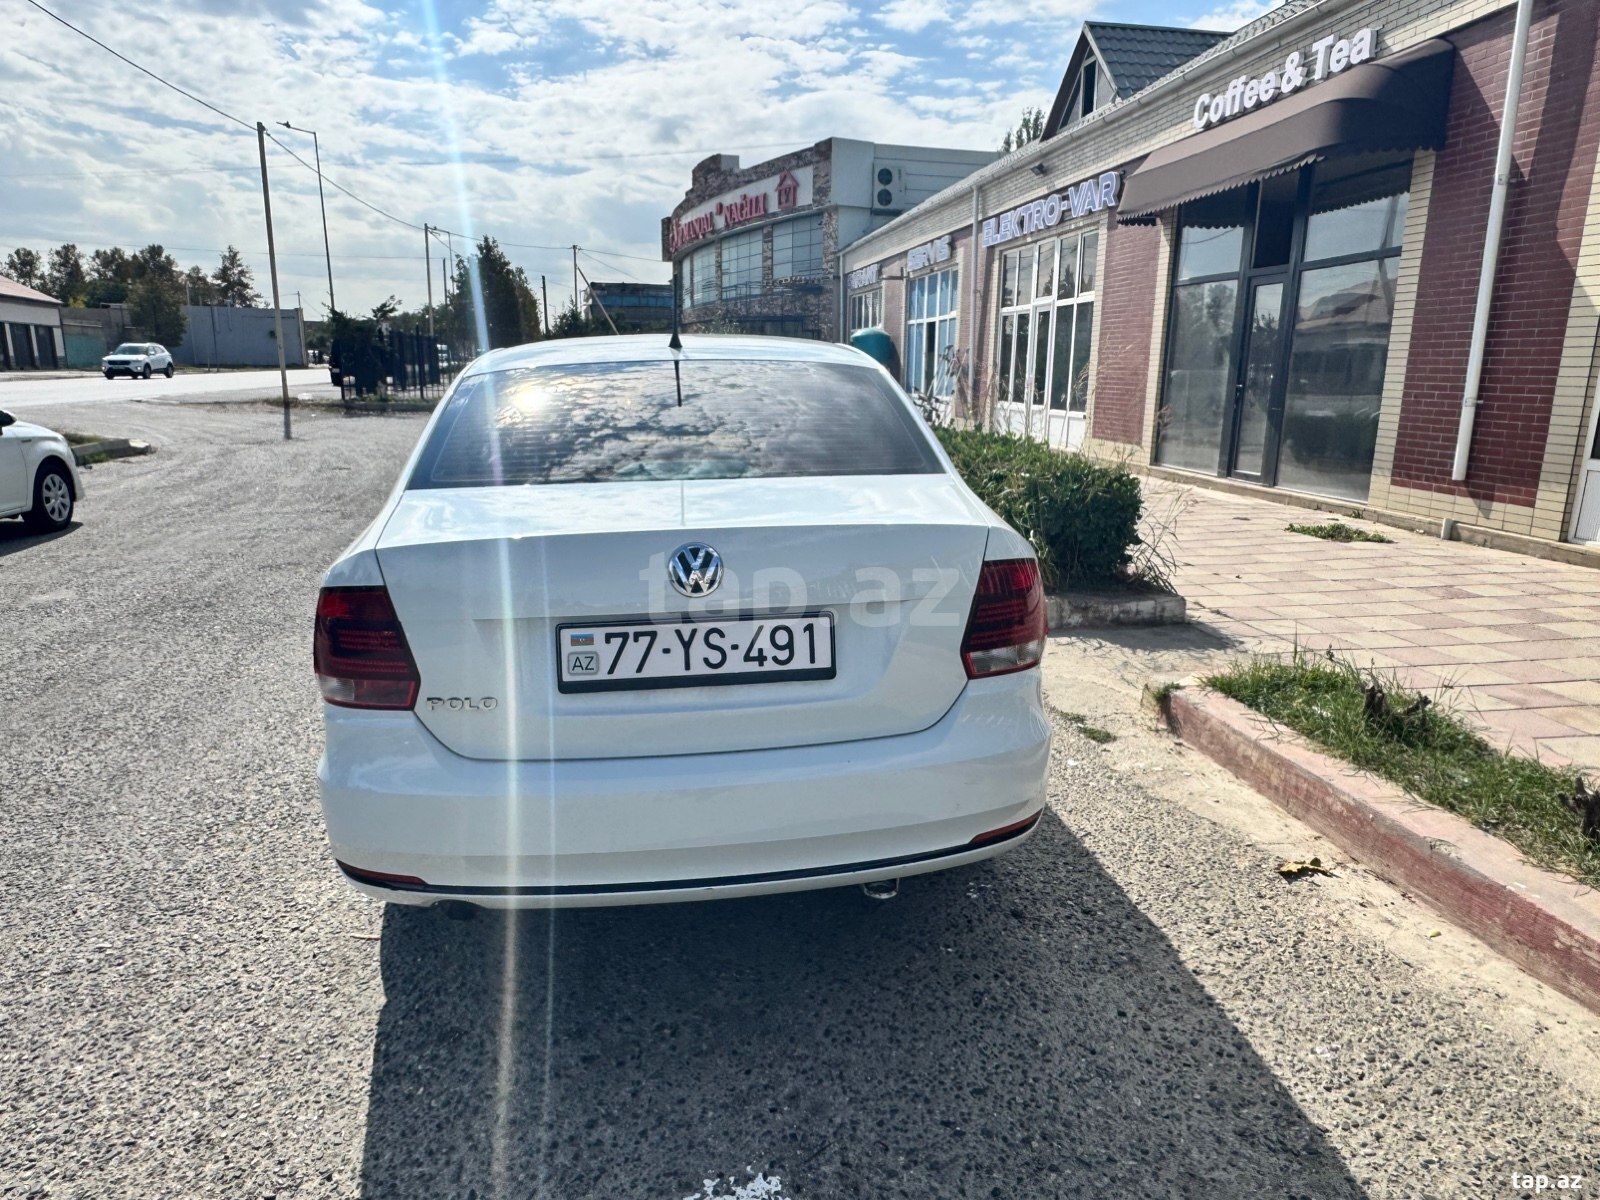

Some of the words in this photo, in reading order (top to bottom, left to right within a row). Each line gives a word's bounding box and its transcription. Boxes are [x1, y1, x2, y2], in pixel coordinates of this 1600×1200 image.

[1193, 71, 1280, 129] Coffee
[1281, 51, 1307, 94] &
[1311, 28, 1377, 81] Tea
[982, 171, 1120, 248] ELEKTRO-VAR
[571, 656, 595, 672] AZ
[604, 623, 816, 675] 77-YS-491
[426, 696, 498, 711] POLO
